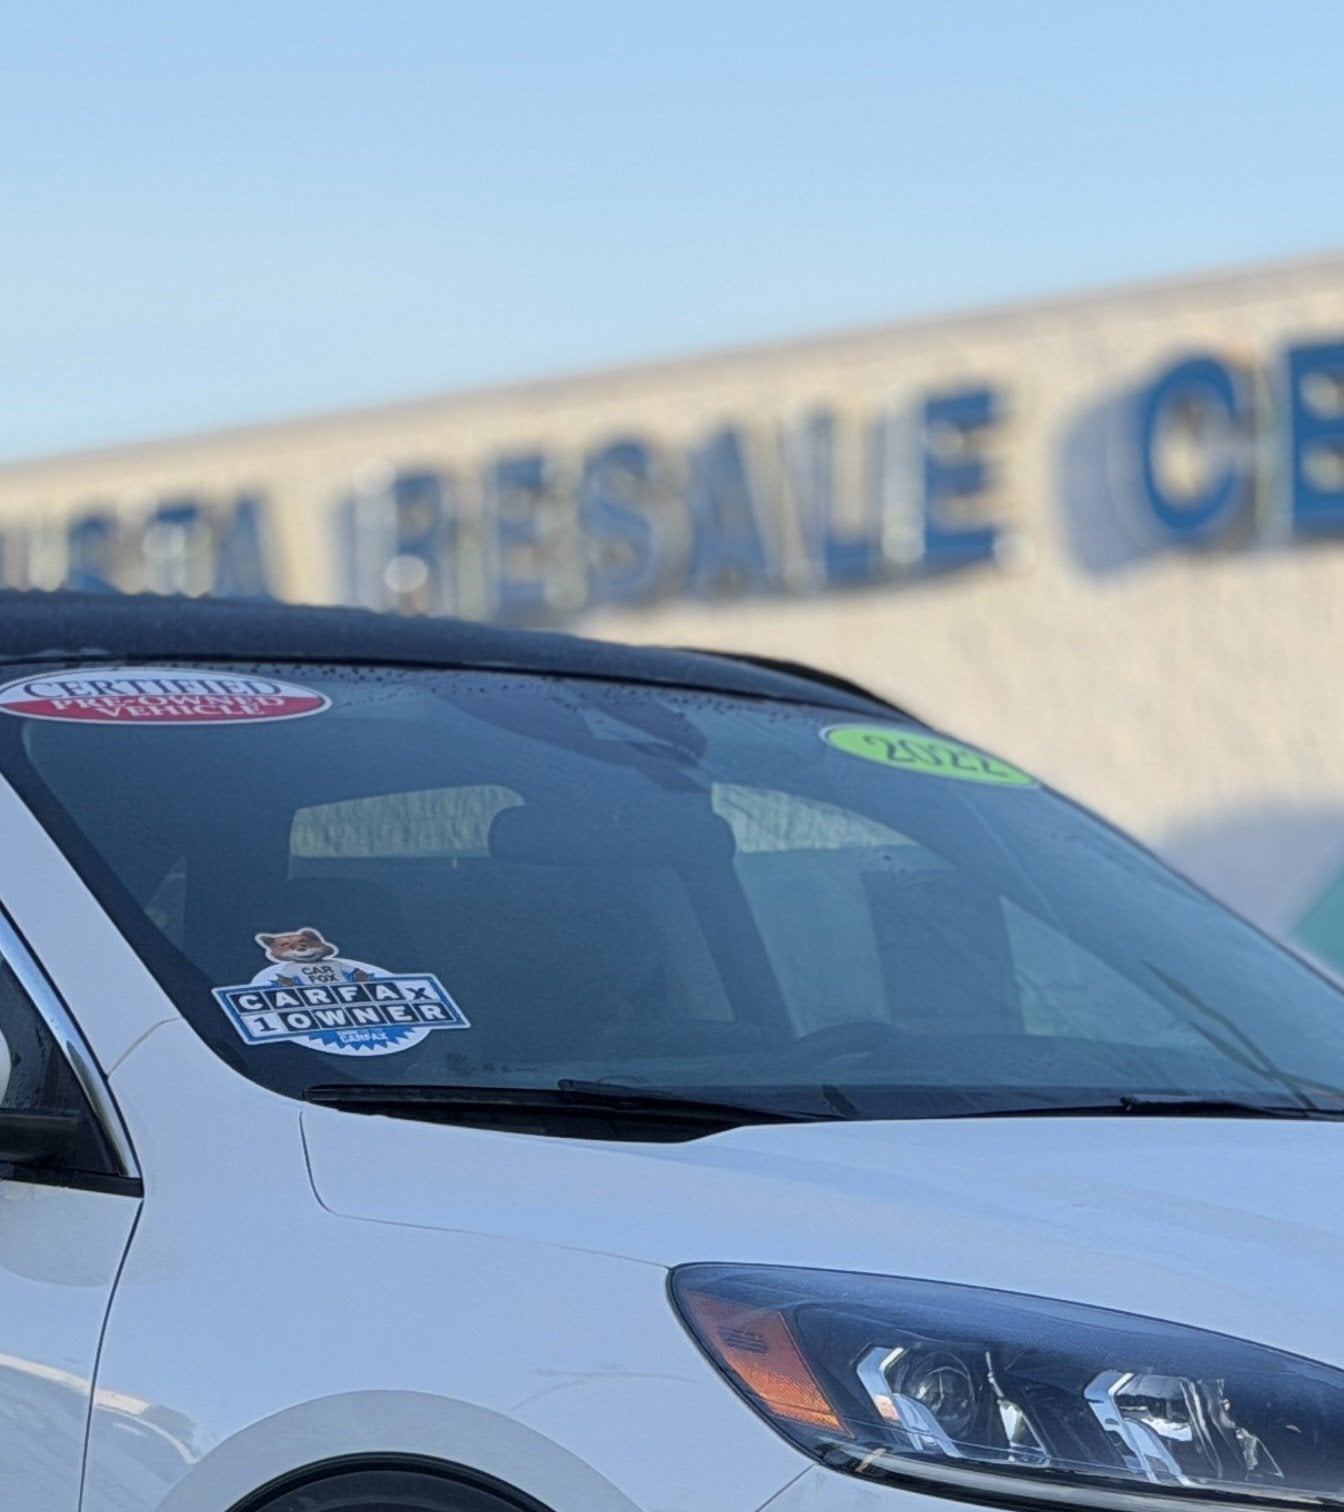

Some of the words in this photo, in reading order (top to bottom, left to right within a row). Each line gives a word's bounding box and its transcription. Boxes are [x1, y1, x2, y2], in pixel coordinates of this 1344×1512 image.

[23, 678, 283, 700] CERTIFIED
[53, 694, 287, 711] PRE-OWNED
[96, 704, 266, 719] VEHICLE
[301, 965, 334, 976] CAR
[308, 974, 339, 984] FOX
[237, 983, 433, 1011] CARFAX
[254, 1016, 278, 1033] 1
[285, 1003, 448, 1030] OWNER
